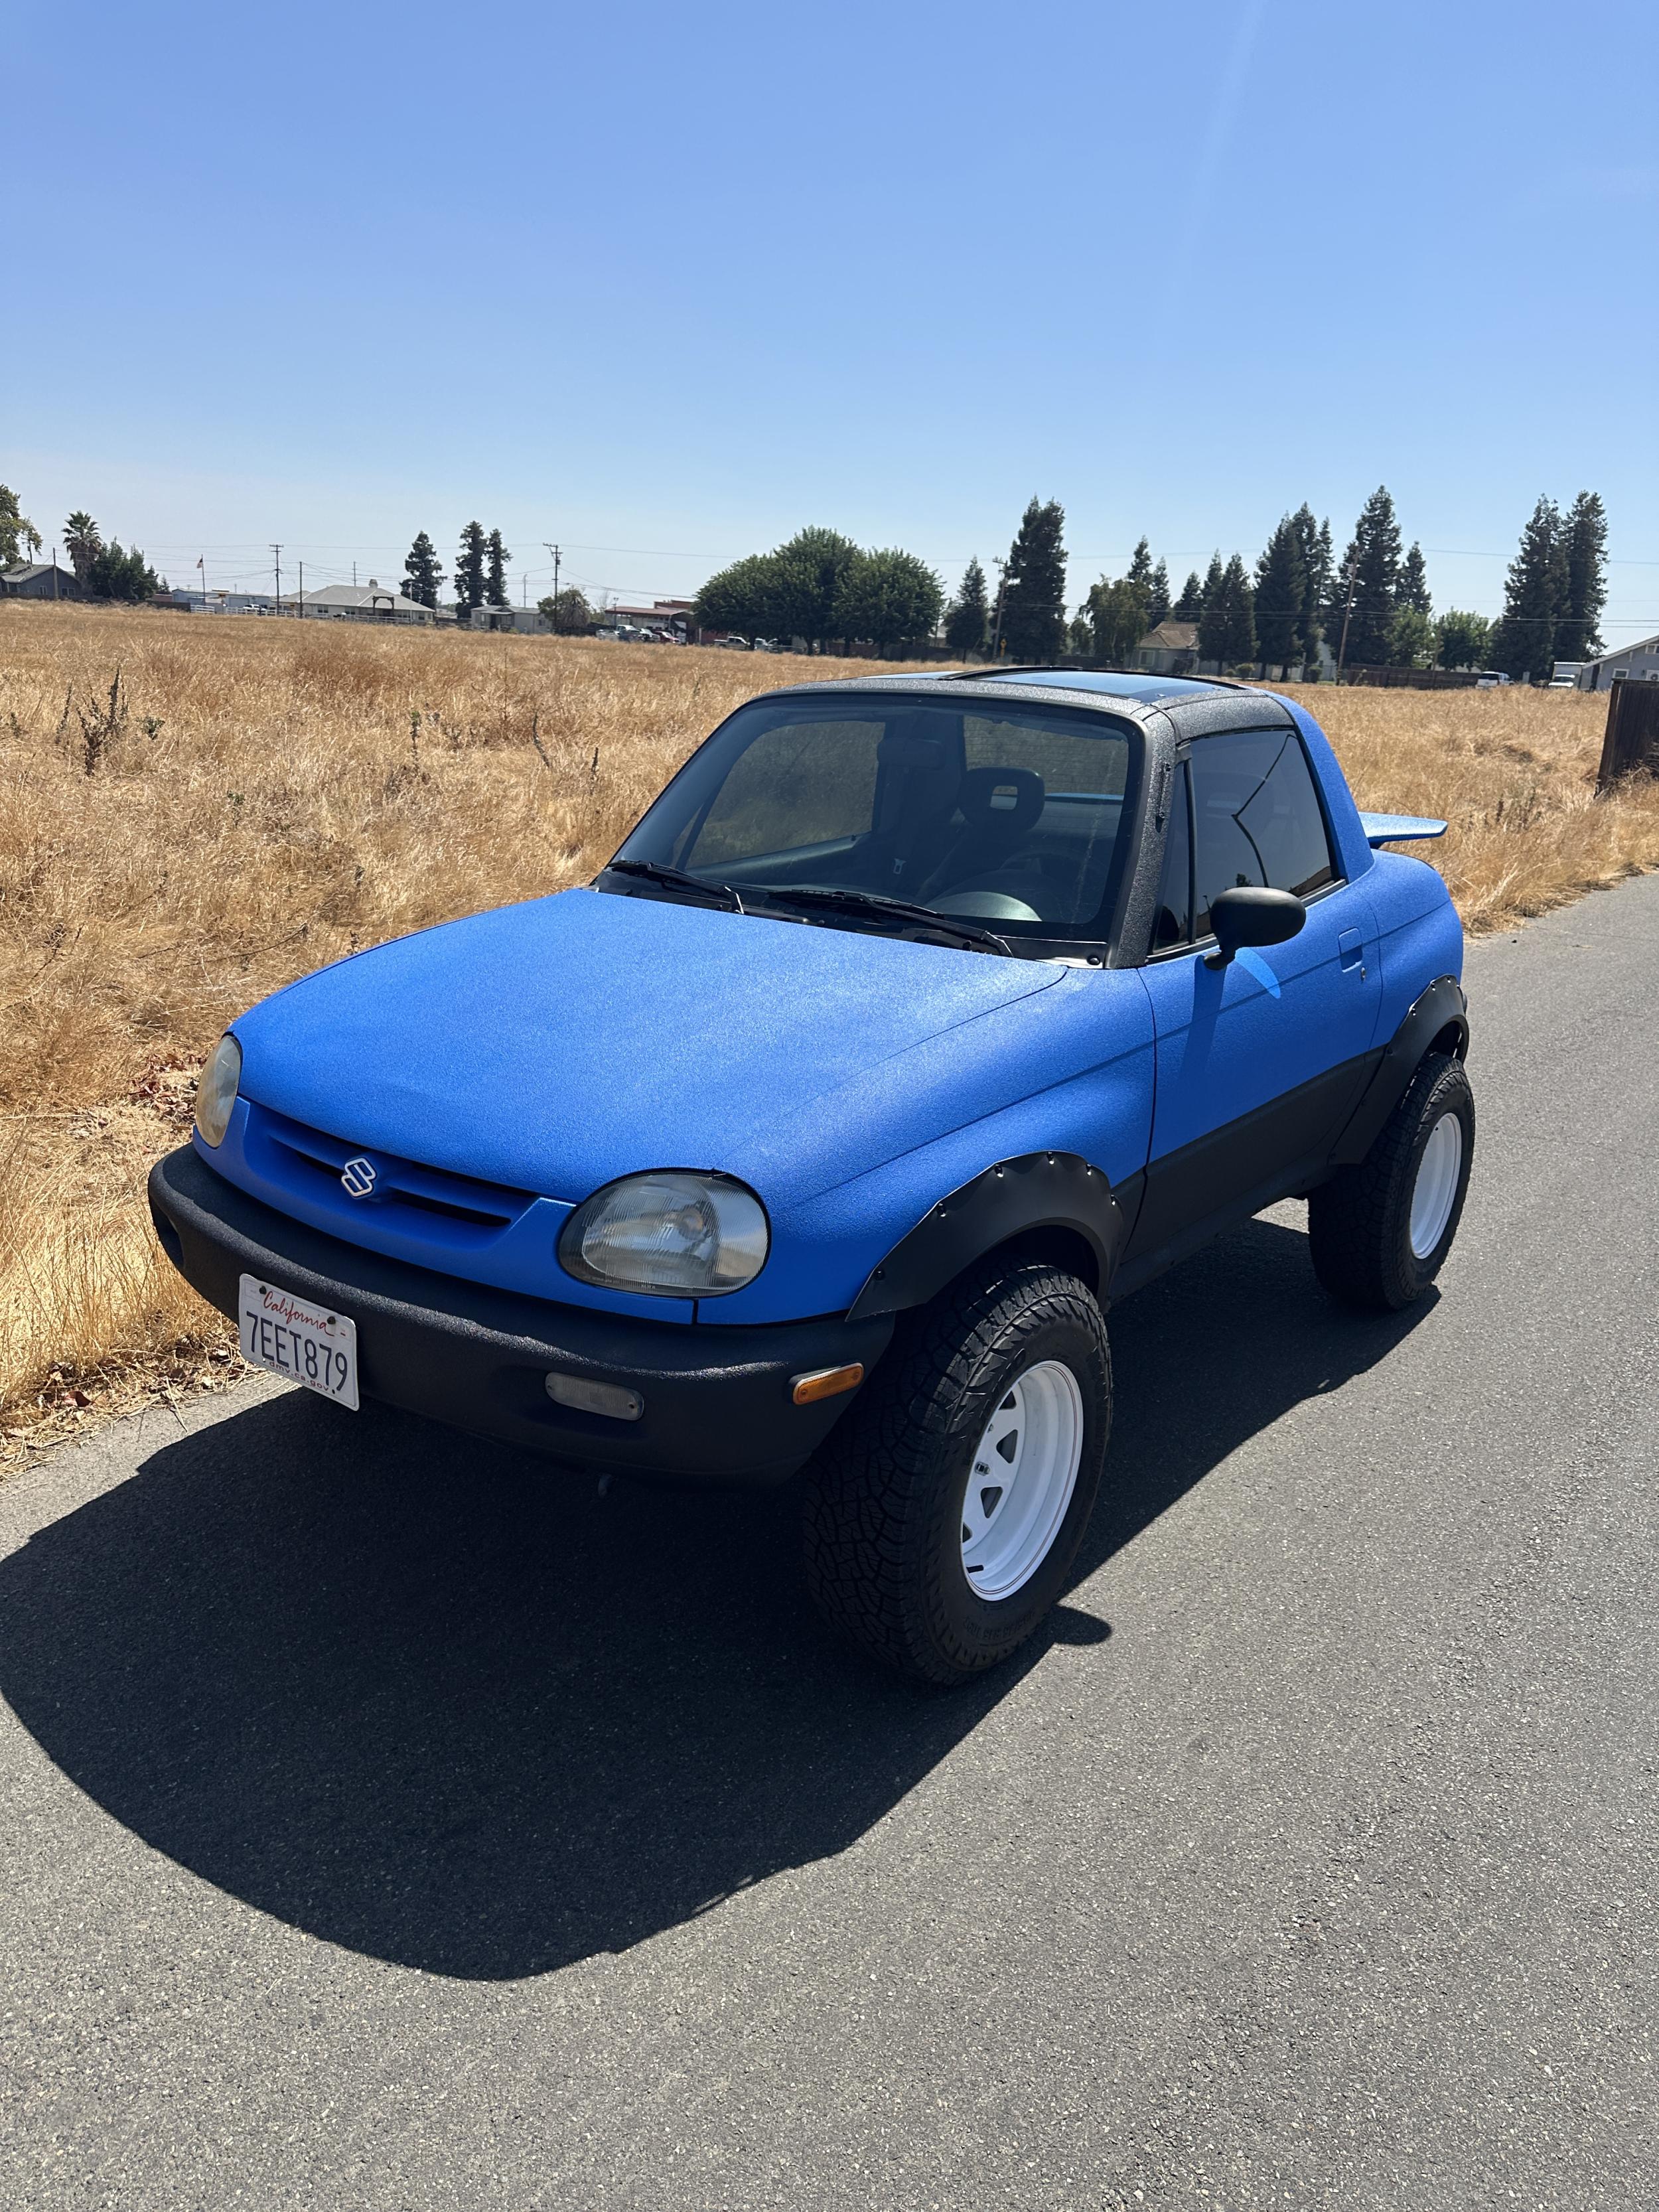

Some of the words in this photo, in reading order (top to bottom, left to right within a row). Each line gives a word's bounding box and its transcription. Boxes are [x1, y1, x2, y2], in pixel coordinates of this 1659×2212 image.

[263, 1290, 335, 1337] California
[246, 1310, 348, 1392] 7EET879
[269, 1361, 330, 1392] dmv.ca.gov
